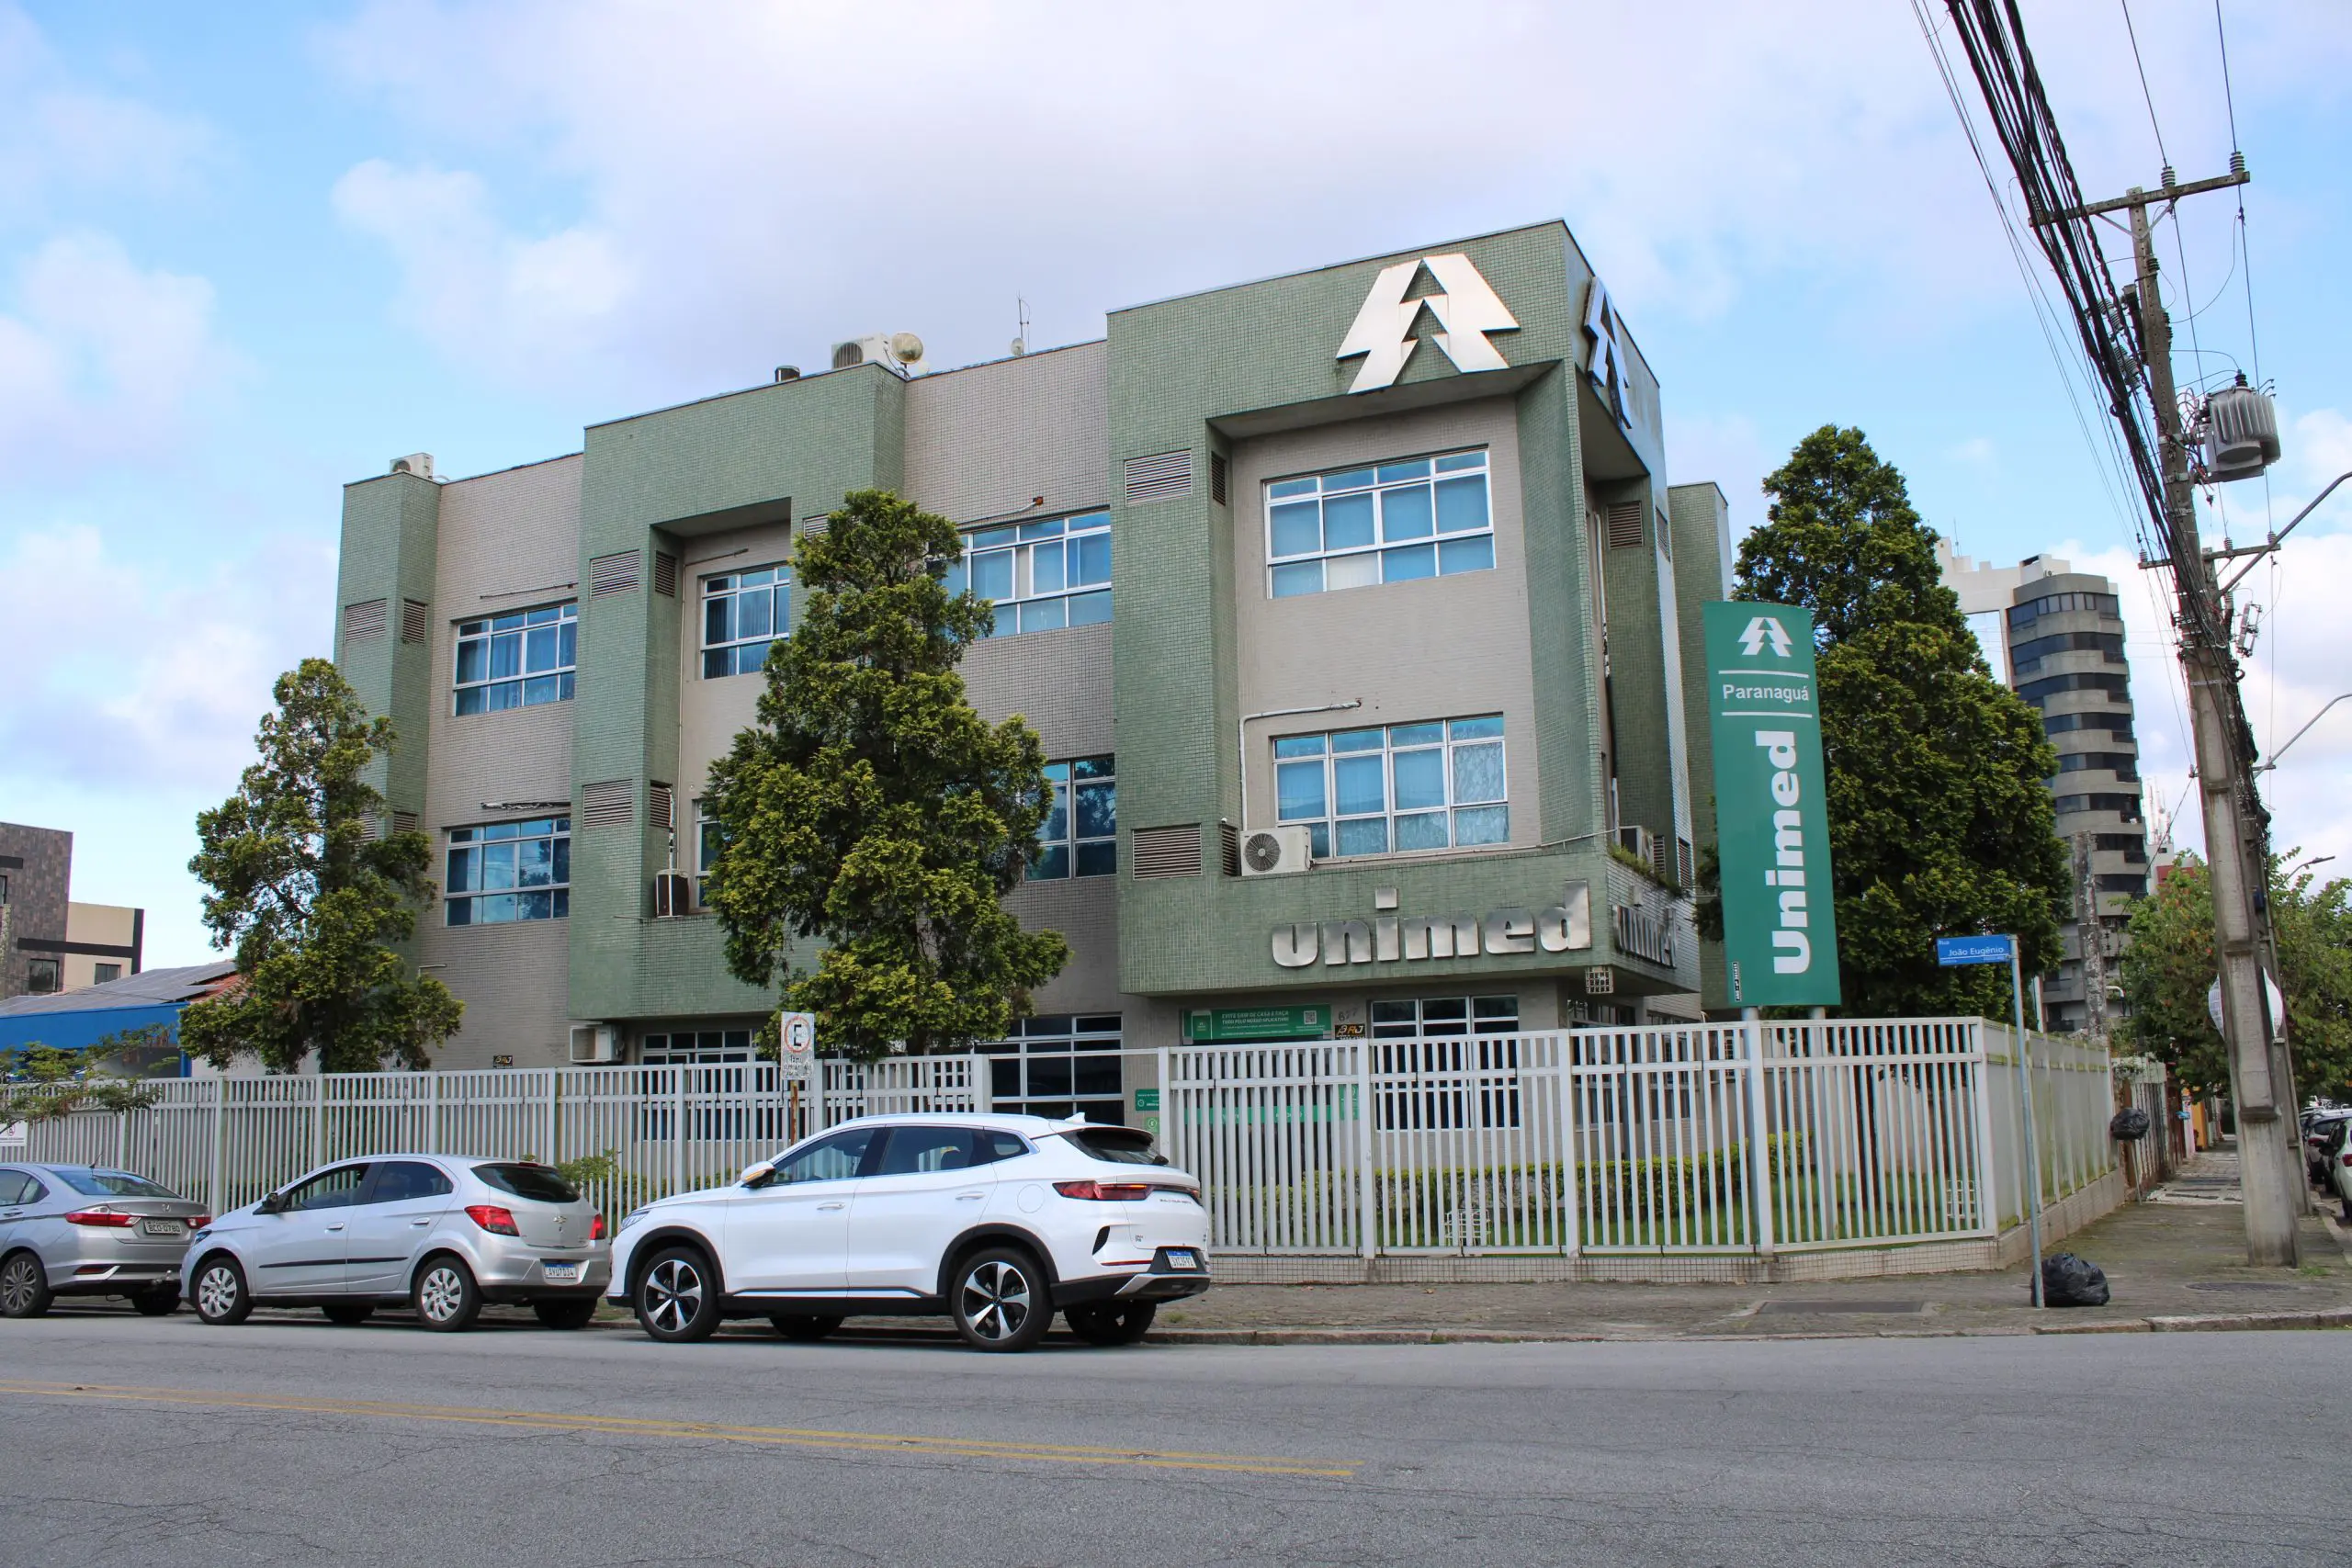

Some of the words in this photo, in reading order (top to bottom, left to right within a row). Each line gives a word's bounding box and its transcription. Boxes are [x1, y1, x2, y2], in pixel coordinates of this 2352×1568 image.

[1722, 684, 1809, 704] Paranaguá
[1949, 948, 1968, 956] João
[1970, 945, 2004, 956] Eugênio
[794, 1024, 802, 1046] E
